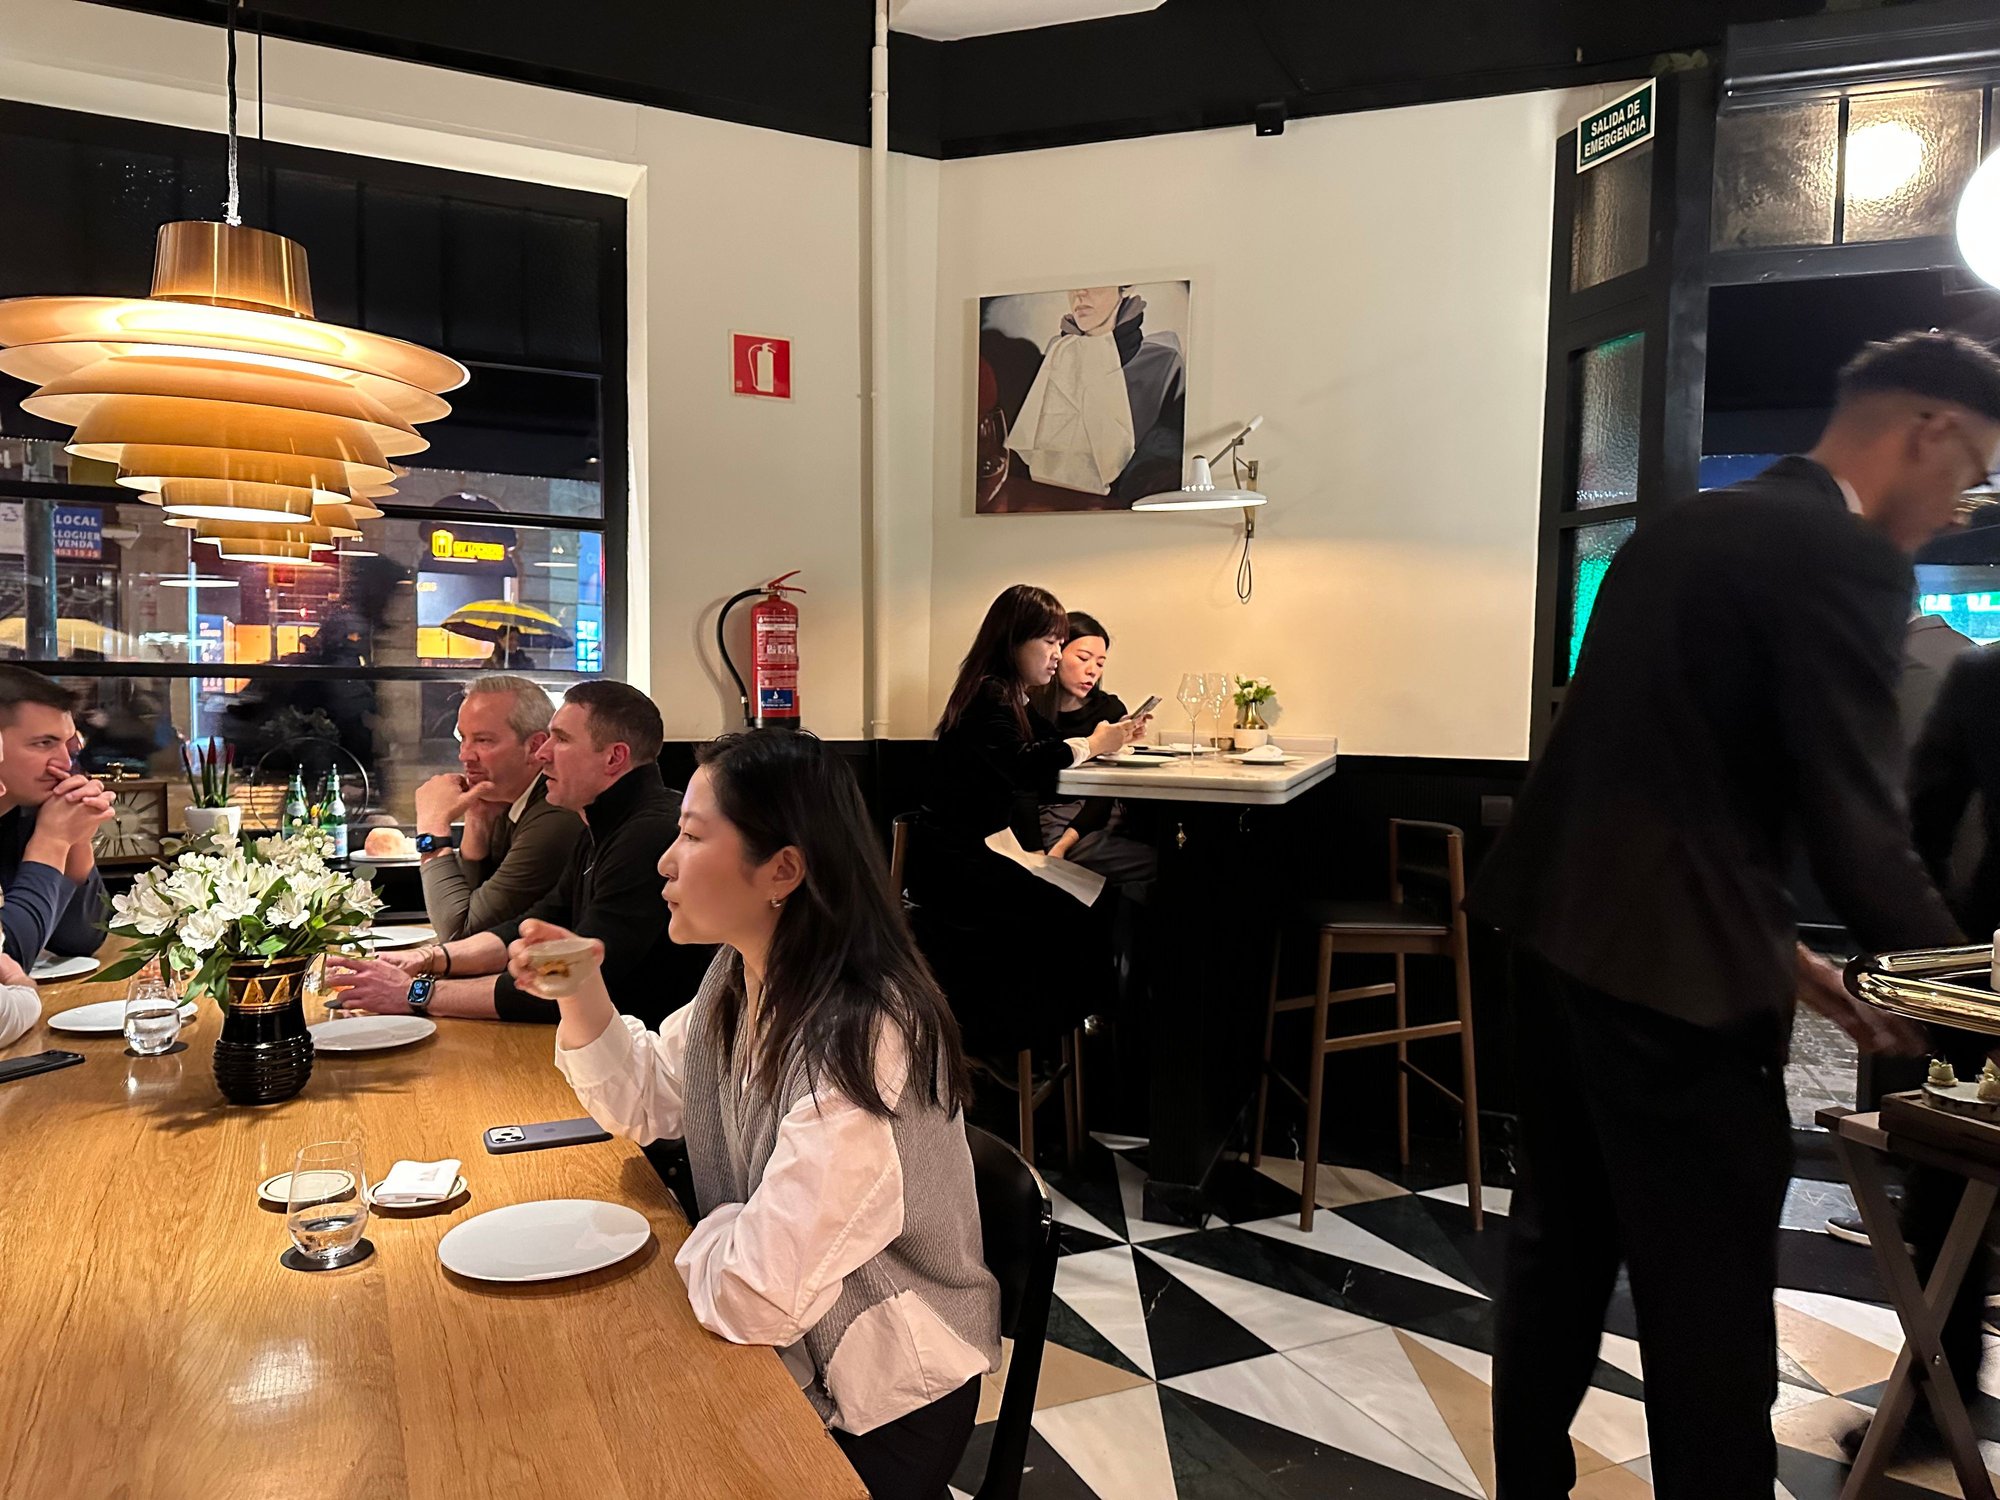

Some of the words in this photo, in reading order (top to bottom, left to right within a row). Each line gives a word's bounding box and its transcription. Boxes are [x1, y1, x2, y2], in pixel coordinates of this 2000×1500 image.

[1591, 108, 1625, 137] SALIDA
[1627, 99, 1640, 119] DE
[1584, 115, 1646, 157] EMERGENCIA
[55, 514, 98, 527] LOCAL
[57, 539, 94, 549] VENDA
